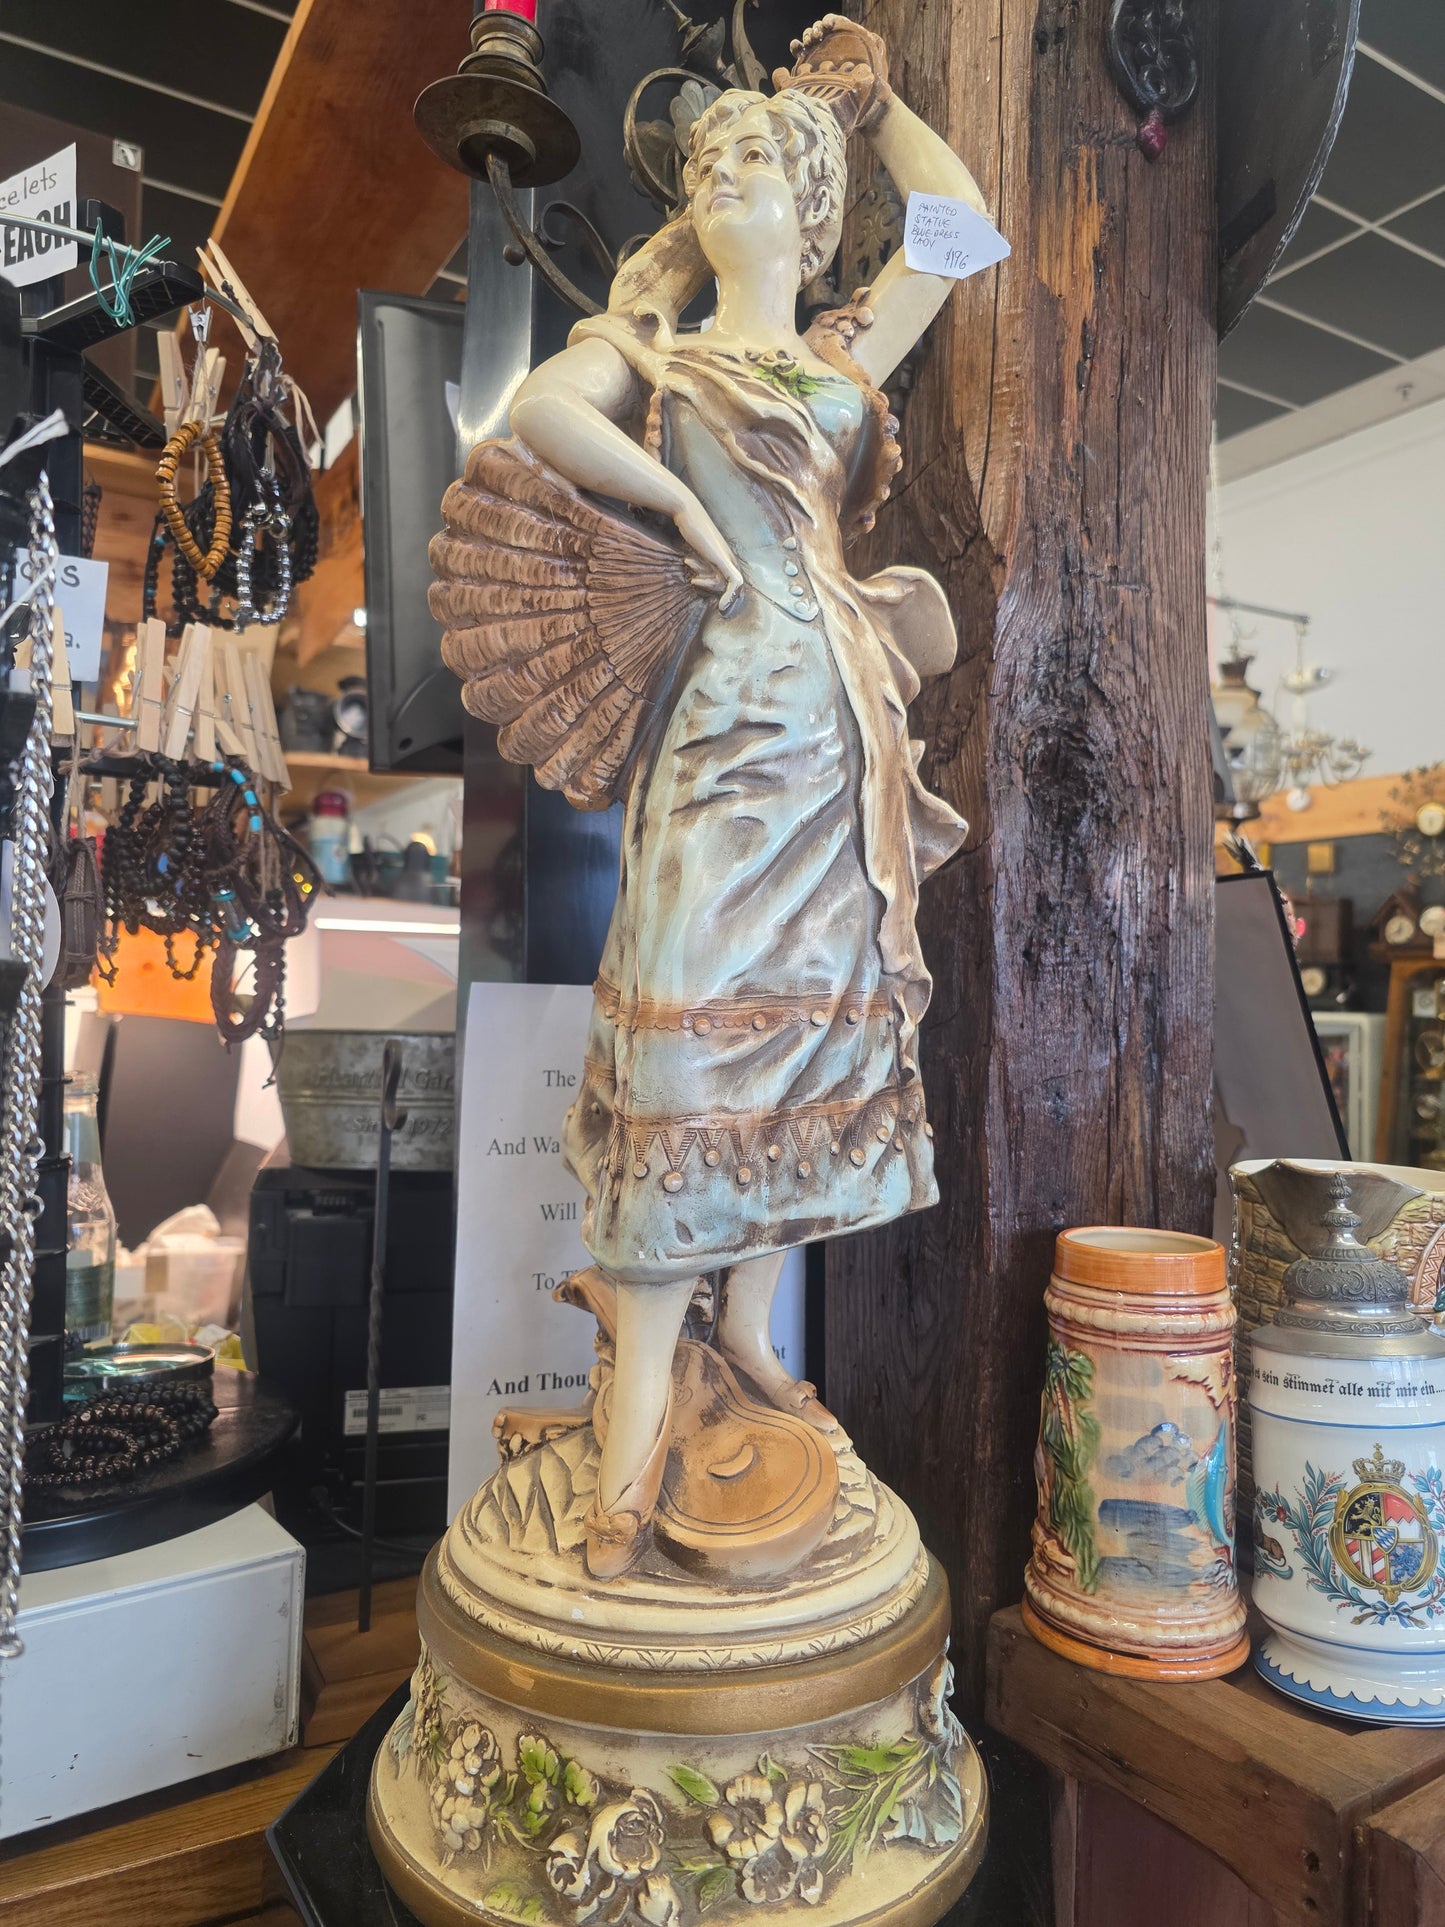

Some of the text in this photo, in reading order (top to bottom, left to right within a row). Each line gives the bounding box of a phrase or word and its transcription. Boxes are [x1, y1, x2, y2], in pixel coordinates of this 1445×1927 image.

[919, 202, 957, 217] PAINTED
[915, 213, 951, 229] STATUE
[912, 235, 936, 251] LADY
[543, 1069, 577, 1087] The
[486, 1137, 527, 1156] And
[540, 1202, 578, 1222] Will
[531, 1273, 556, 1291] To
[486, 1372, 592, 1396] And Thou
[1262, 1370, 1279, 1386] sein
[1283, 1372, 1340, 1394] stimmet
[1339, 1382, 1364, 1398] alle
[1367, 1381, 1395, 1398] mit
[1395, 1382, 1418, 1397] mir
